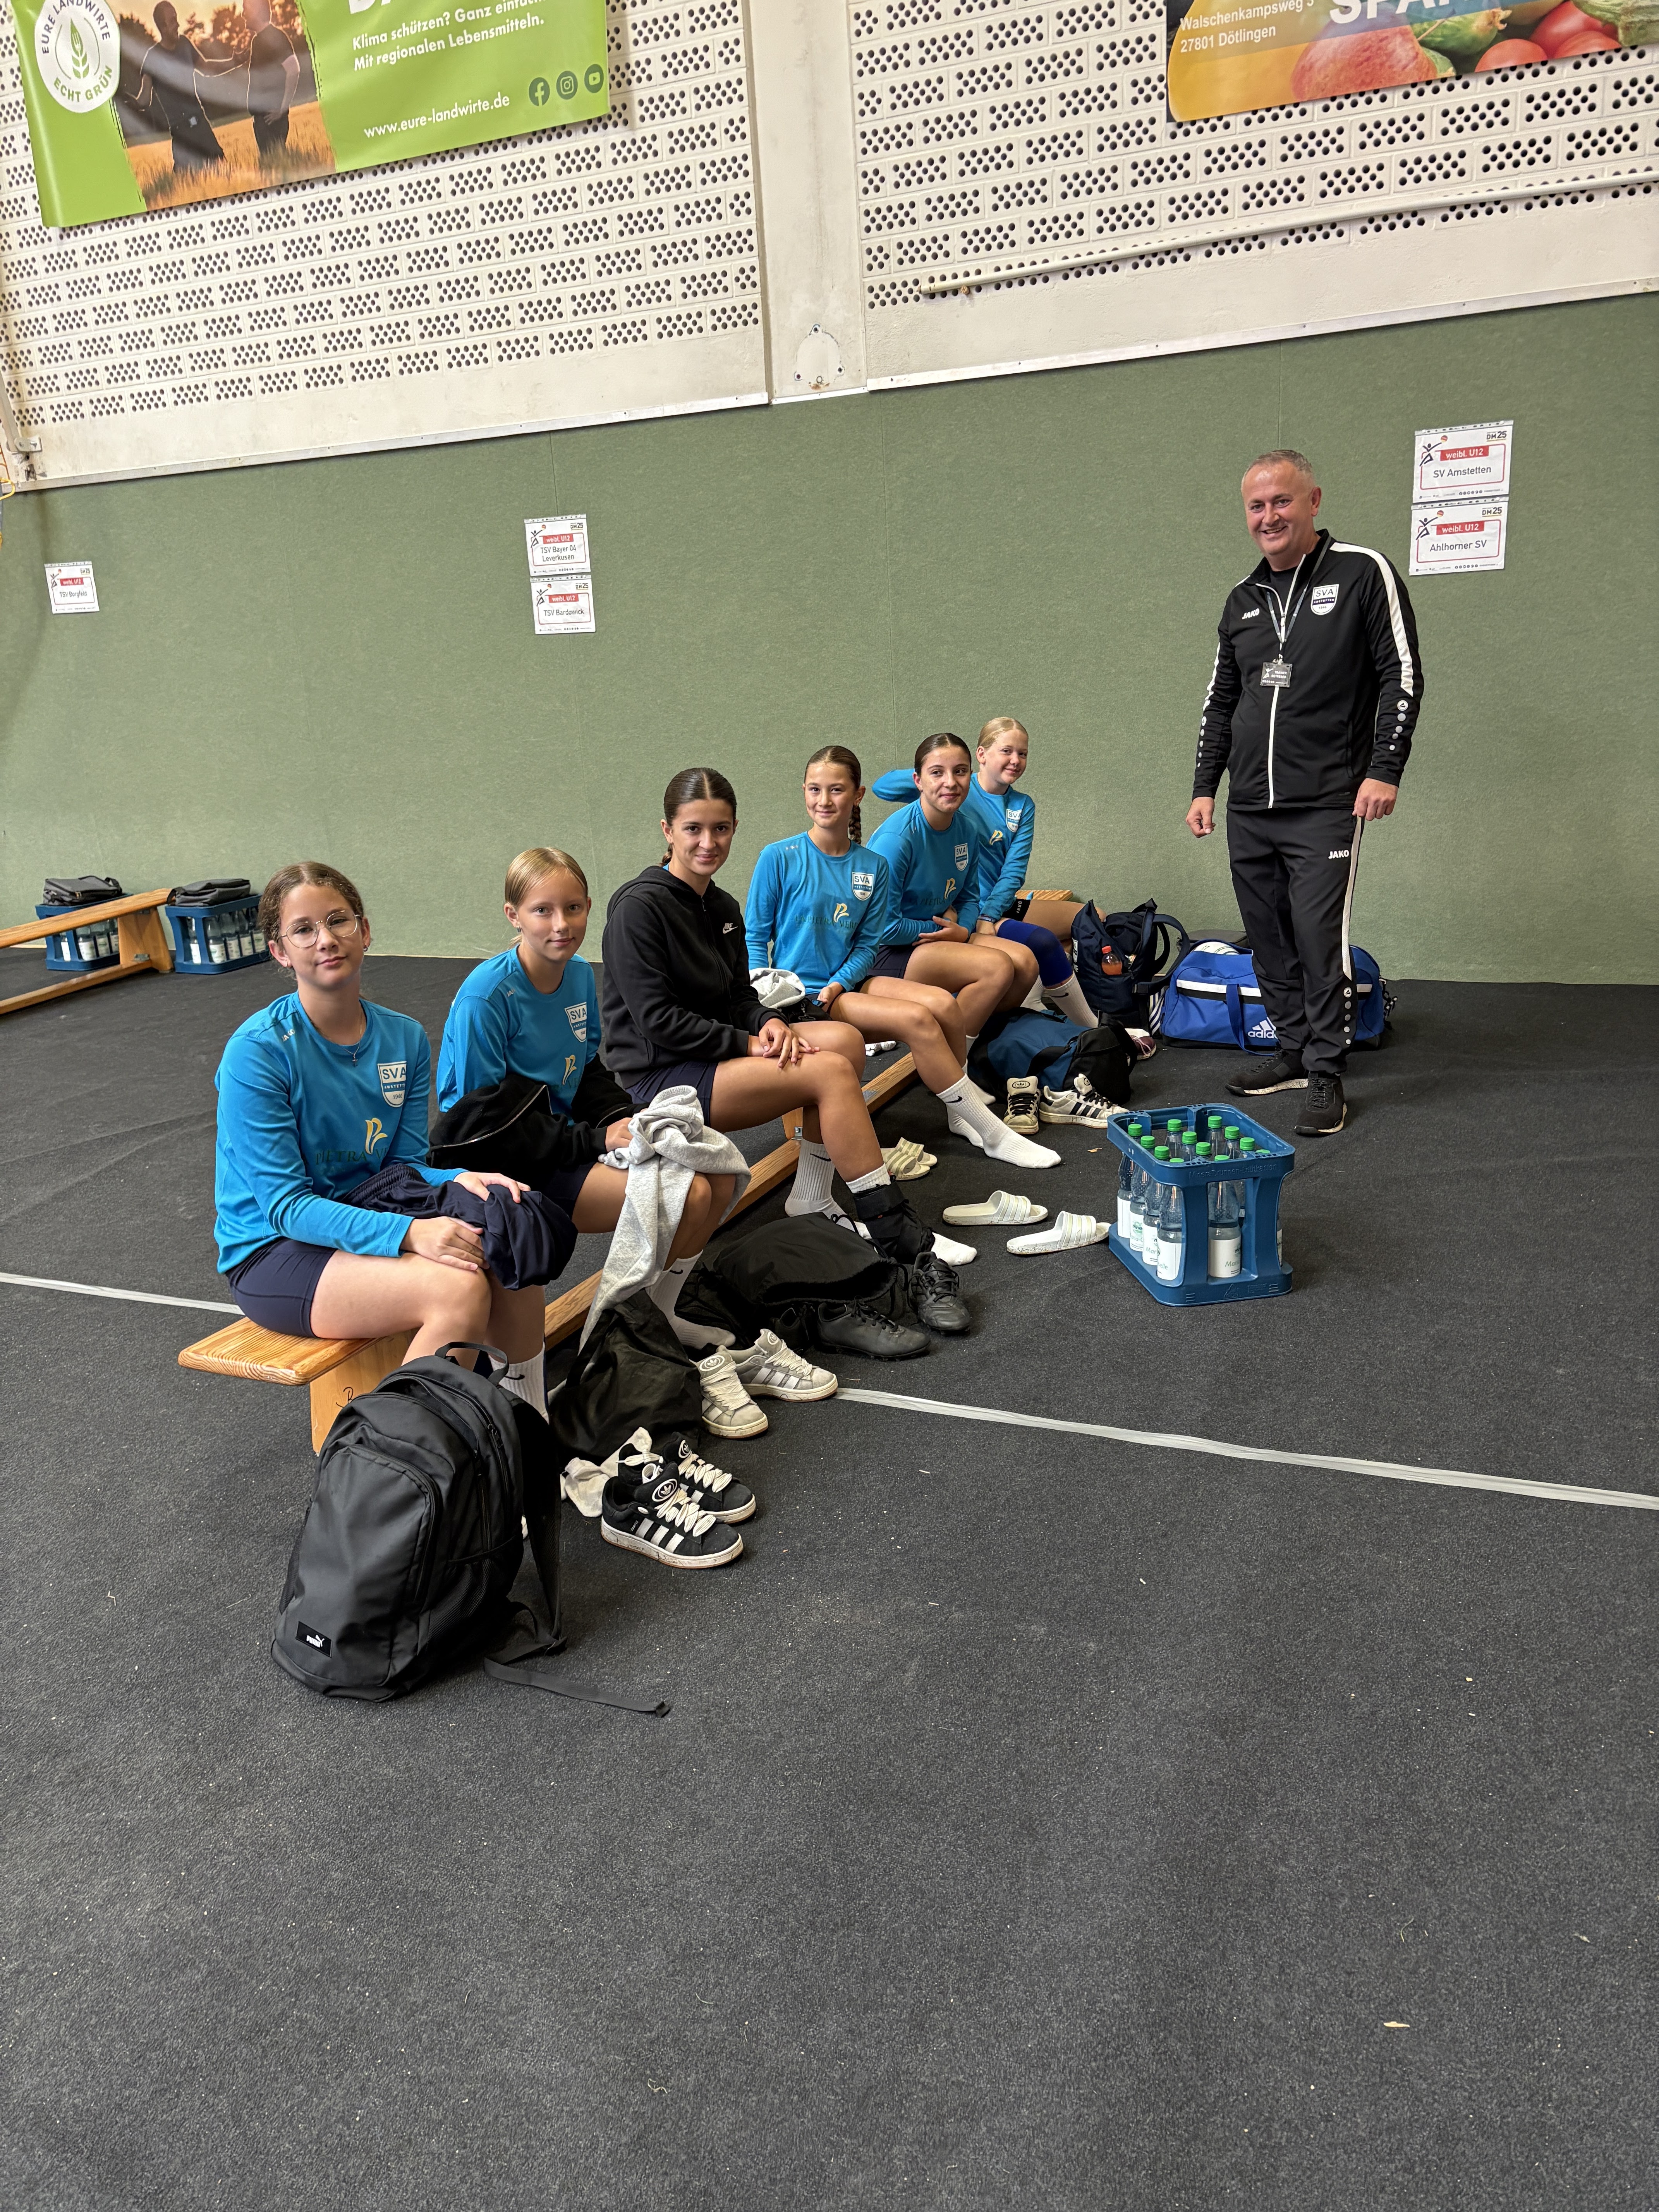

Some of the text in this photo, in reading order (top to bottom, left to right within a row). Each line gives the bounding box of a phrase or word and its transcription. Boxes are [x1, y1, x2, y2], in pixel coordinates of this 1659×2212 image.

[1180, 0, 1302, 31] Walschenkampsweg
[353, 0, 545, 50] Klima schützen? Ganz einfa
[41, 14, 55, 54] EURE
[1180, 26, 1276, 53] 27801 Dötlingen
[354, 12, 544, 71] Mit regionalen Lebensmitteln.
[54, 65, 112, 102] ECHT GRÜN
[364, 92, 510, 138] www.eure-landwirte.de
[1486, 430, 1507, 440] DM25
[1446, 448, 1483, 459] weibl. U12
[1433, 467, 1491, 477] SV Amstetten
[1482, 507, 1502, 515] DM25
[1430, 540, 1487, 551] Ahlhorner SV
[1316, 589, 1333, 597] SVA
[1242, 608, 1260, 620] JAKO
[957, 847, 966, 855] SVA
[1328, 850, 1349, 859] JAKO
[570, 1008, 586, 1020] SVA
[1247, 1029, 1278, 1039] adid
[382, 1067, 406, 1080] SVA
[306, 1635, 321, 1648] PUMA
